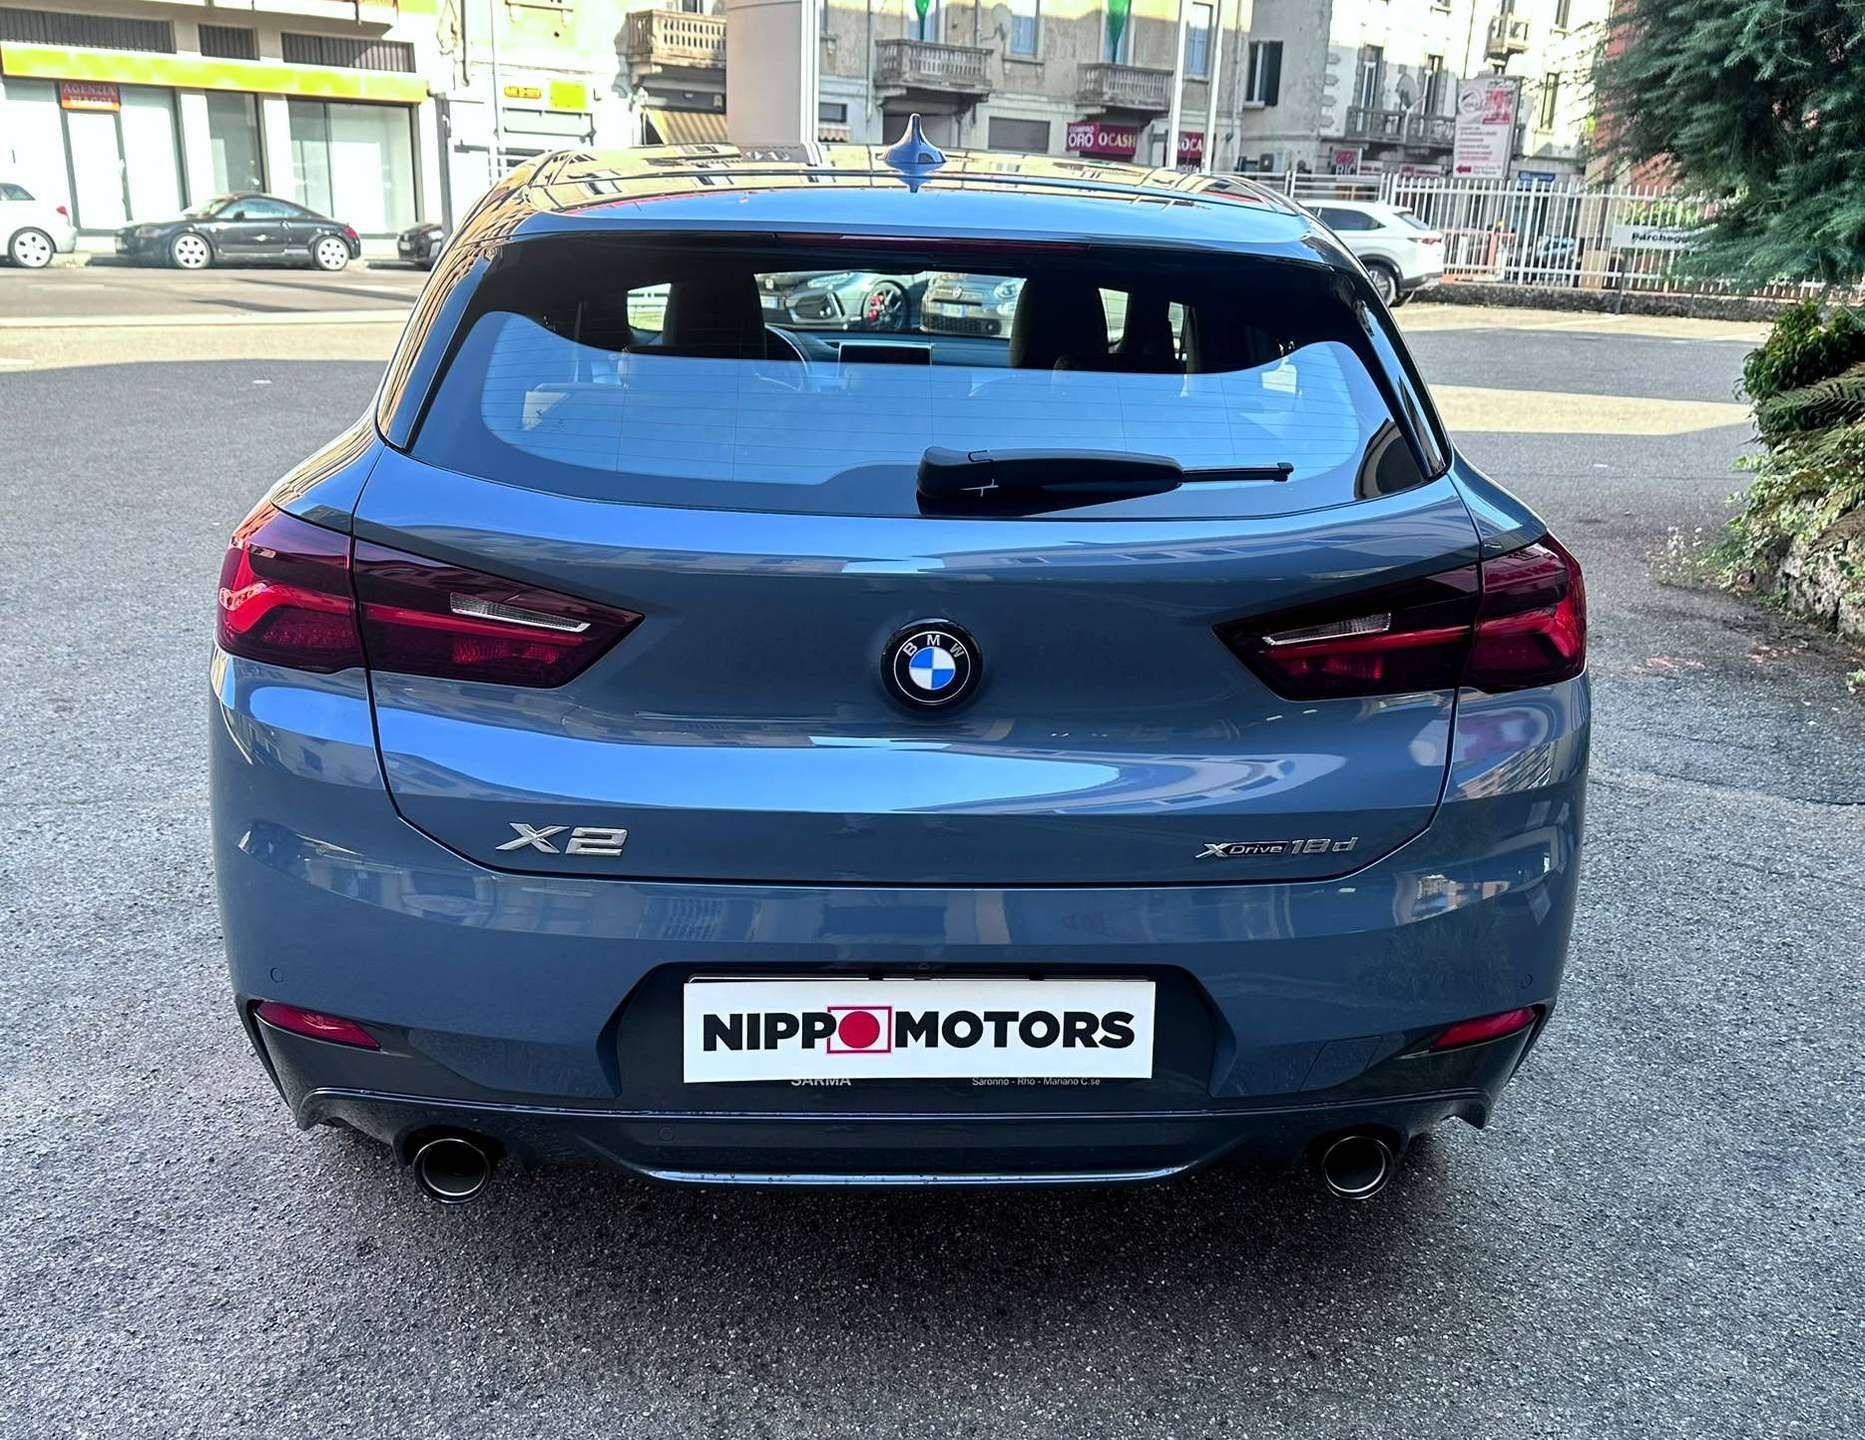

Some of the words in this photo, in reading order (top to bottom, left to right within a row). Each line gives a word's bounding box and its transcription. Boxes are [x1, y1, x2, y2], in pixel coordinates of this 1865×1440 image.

[1068, 132, 1094, 147] ORO
[903, 634, 964, 657] BMW
[496, 822, 627, 856] X2
[895, 1010, 1135, 1049] MOTORS
[972, 1077, 1010, 1086] Saronno
[1018, 1077, 1035, 1086] Rho
